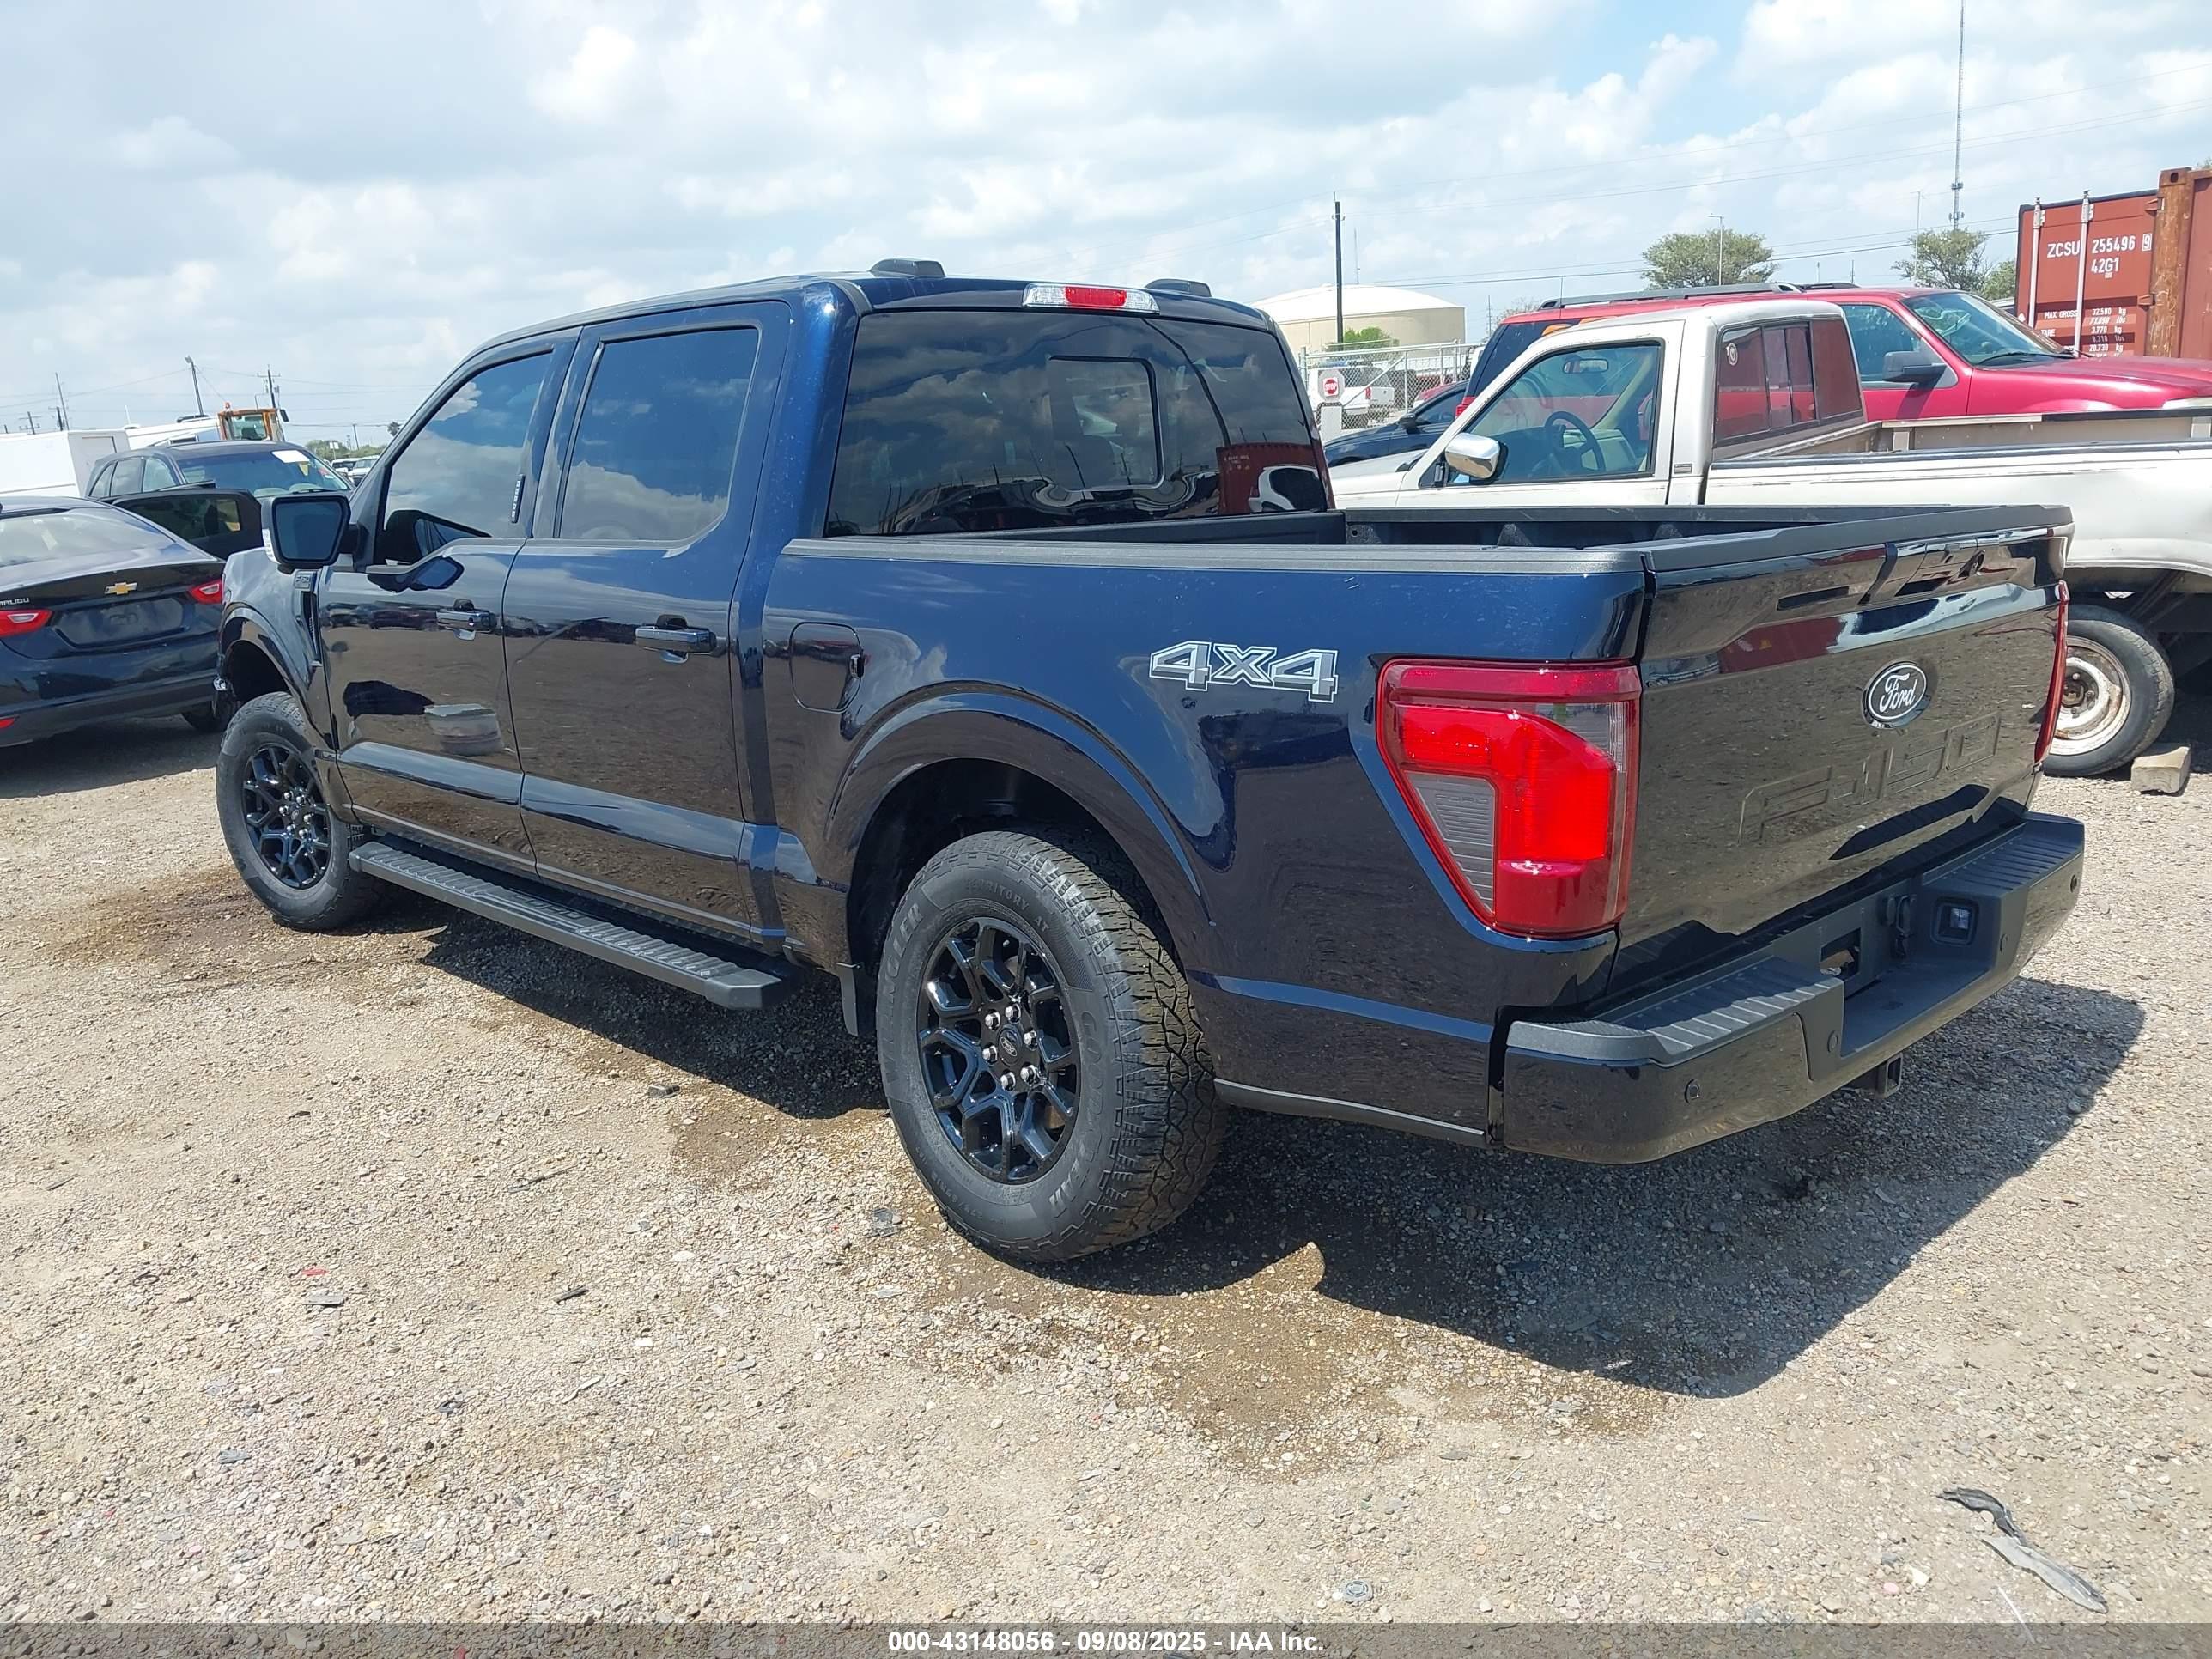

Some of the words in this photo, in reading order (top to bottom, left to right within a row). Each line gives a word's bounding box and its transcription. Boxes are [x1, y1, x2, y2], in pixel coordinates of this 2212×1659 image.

[2047, 240, 2080, 258] ZCSU
[2092, 236, 2136, 254] 255496
[2142, 234, 2151, 250] 9
[2091, 258, 2118, 273] 42G1
[1879, 672, 1918, 713] Ford
[1435, 793, 1489, 806] FORD
[1034, 916, 1049, 932] AT
